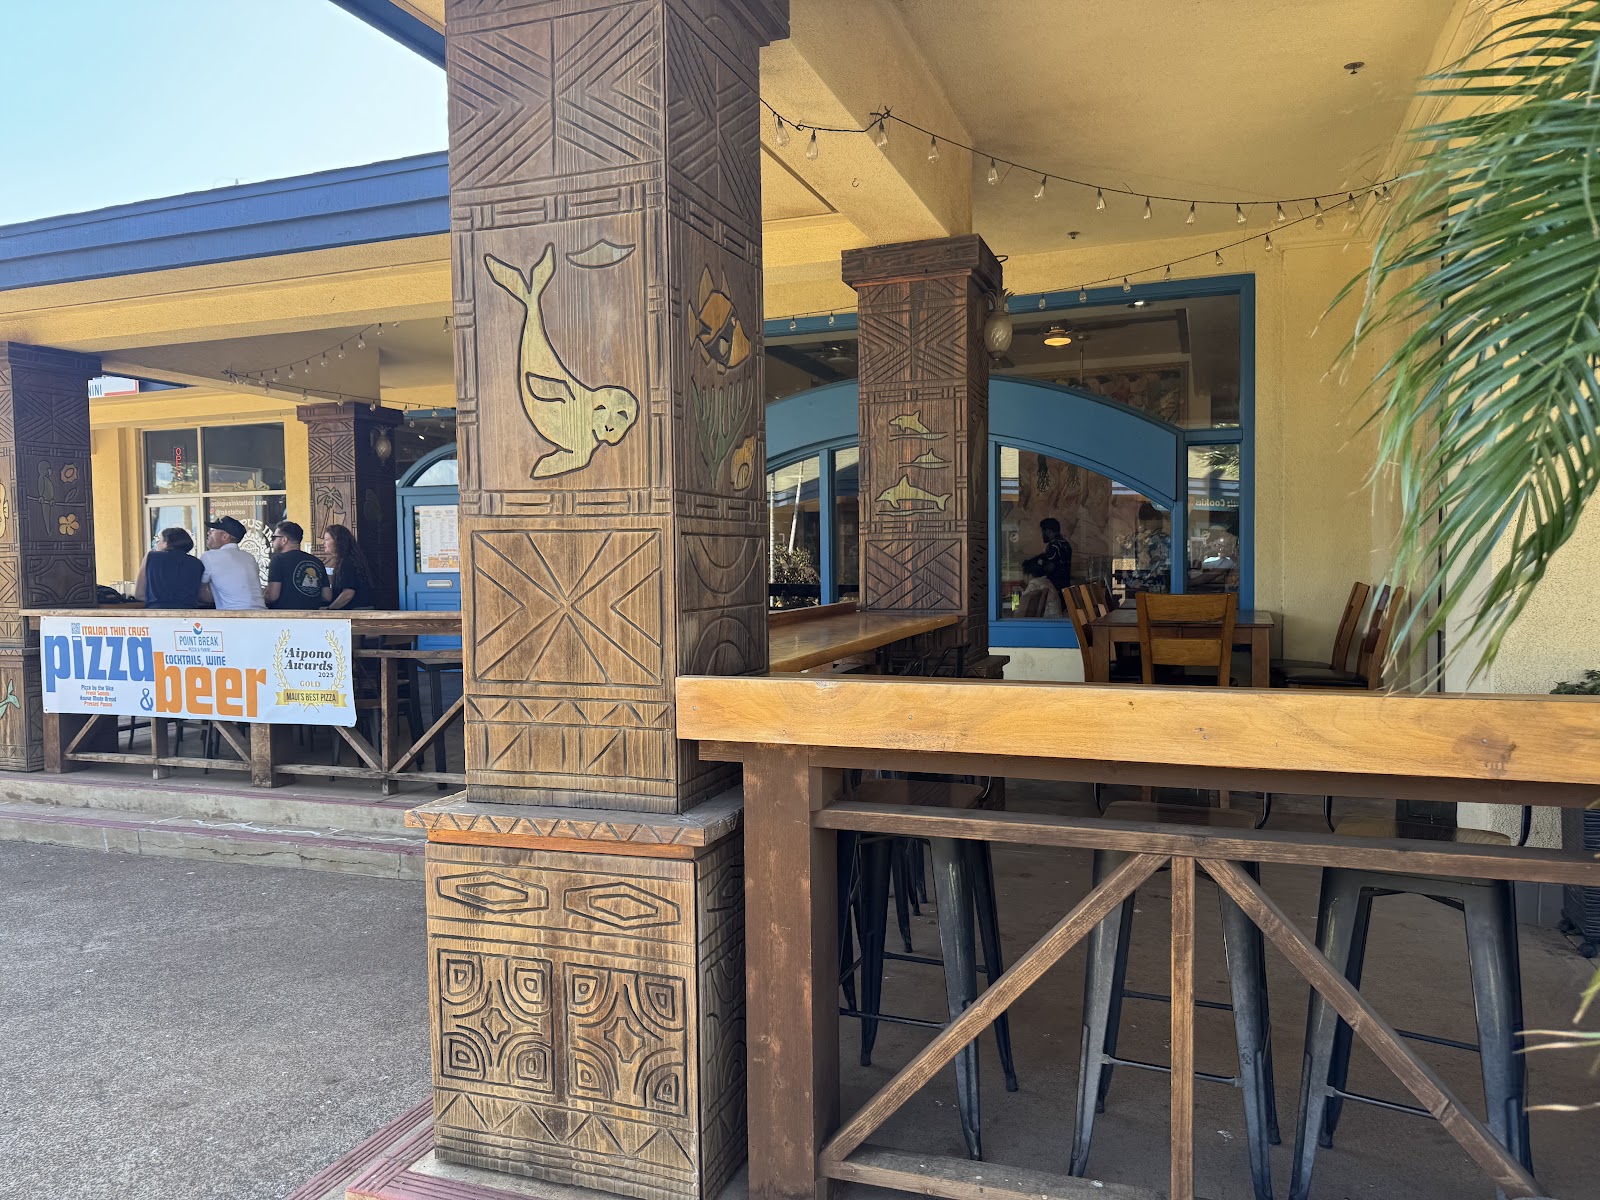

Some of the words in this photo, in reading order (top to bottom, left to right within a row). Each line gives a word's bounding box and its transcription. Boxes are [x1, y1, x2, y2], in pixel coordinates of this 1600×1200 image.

[82, 626, 108, 636] ITALIAN
[110, 627, 126, 636] THIN
[128, 627, 149, 636] CRUST
[179, 636, 197, 646] POINT
[198, 637, 219, 646] BREAK
[44, 635, 155, 692] pizza
[165, 655, 204, 666] COCKTAILS,
[206, 655, 226, 666] WINE
[284, 660, 333, 671] Awards
[153, 652, 266, 717] beer
[140, 688, 154, 711] &
[306, 693, 319, 701] BEST
[320, 694, 336, 702] PIZZA
